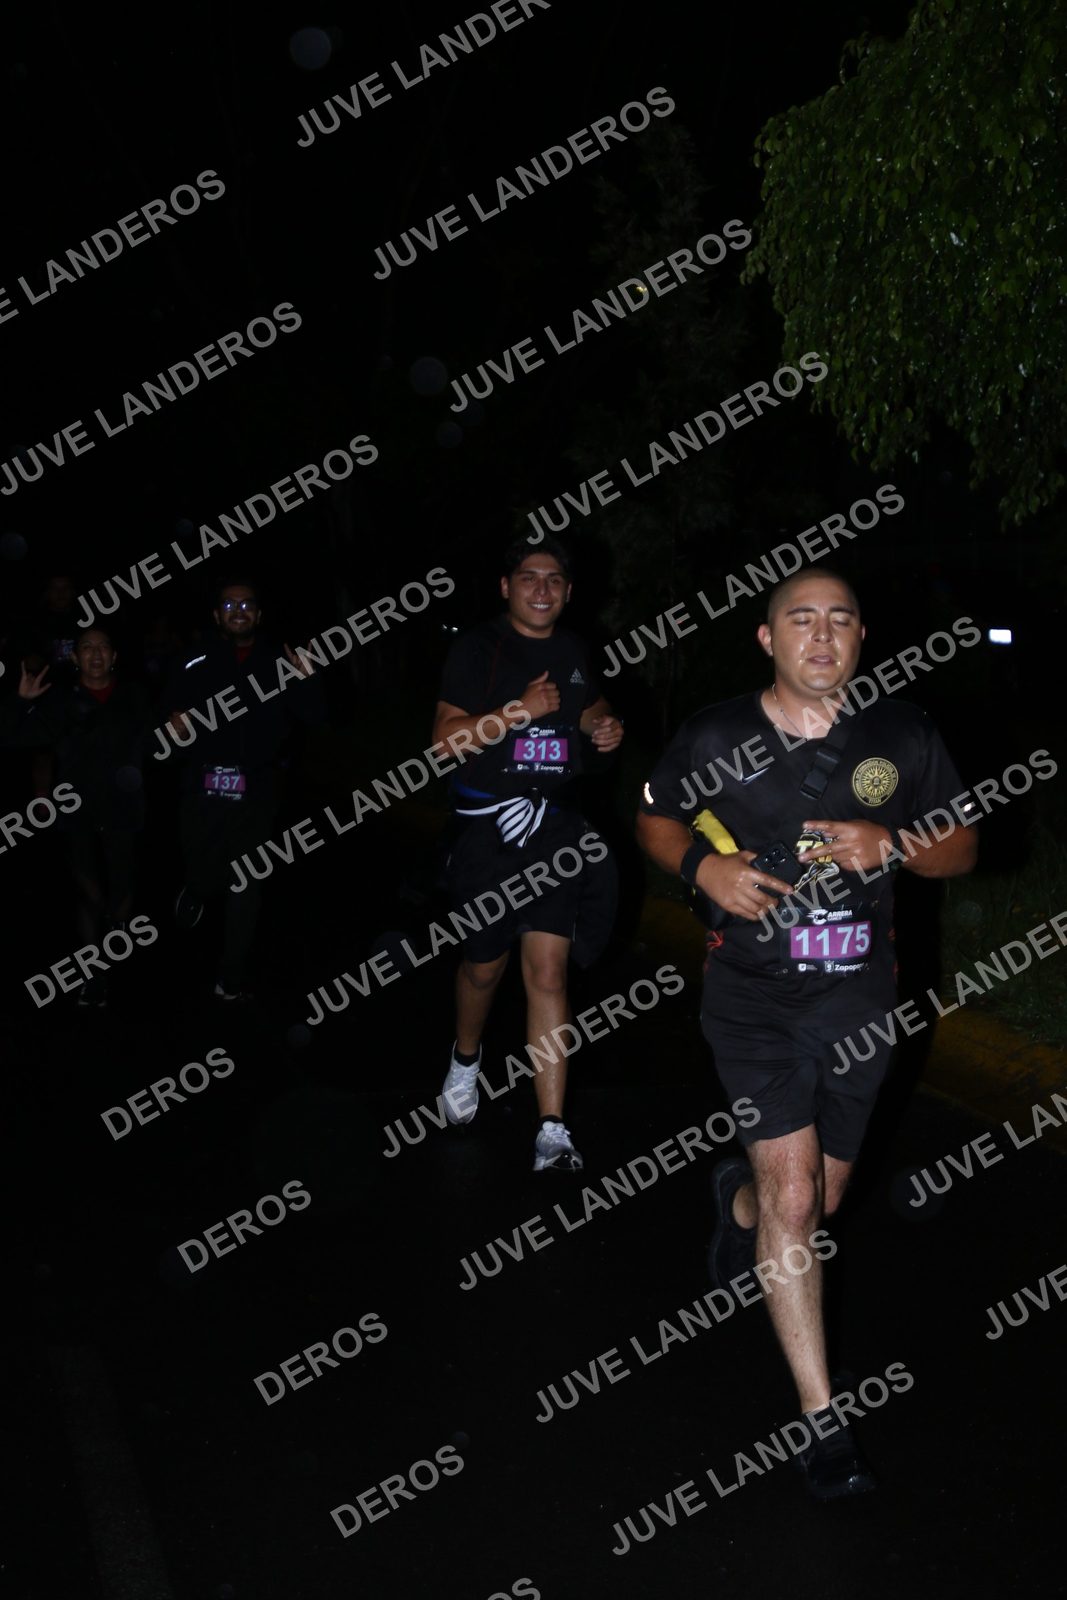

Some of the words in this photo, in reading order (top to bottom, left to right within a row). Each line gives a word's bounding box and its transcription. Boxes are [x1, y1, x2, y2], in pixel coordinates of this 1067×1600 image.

[523, 740, 561, 760] 313
[212, 775, 240, 790] 137
[795, 924, 870, 956] 1175
